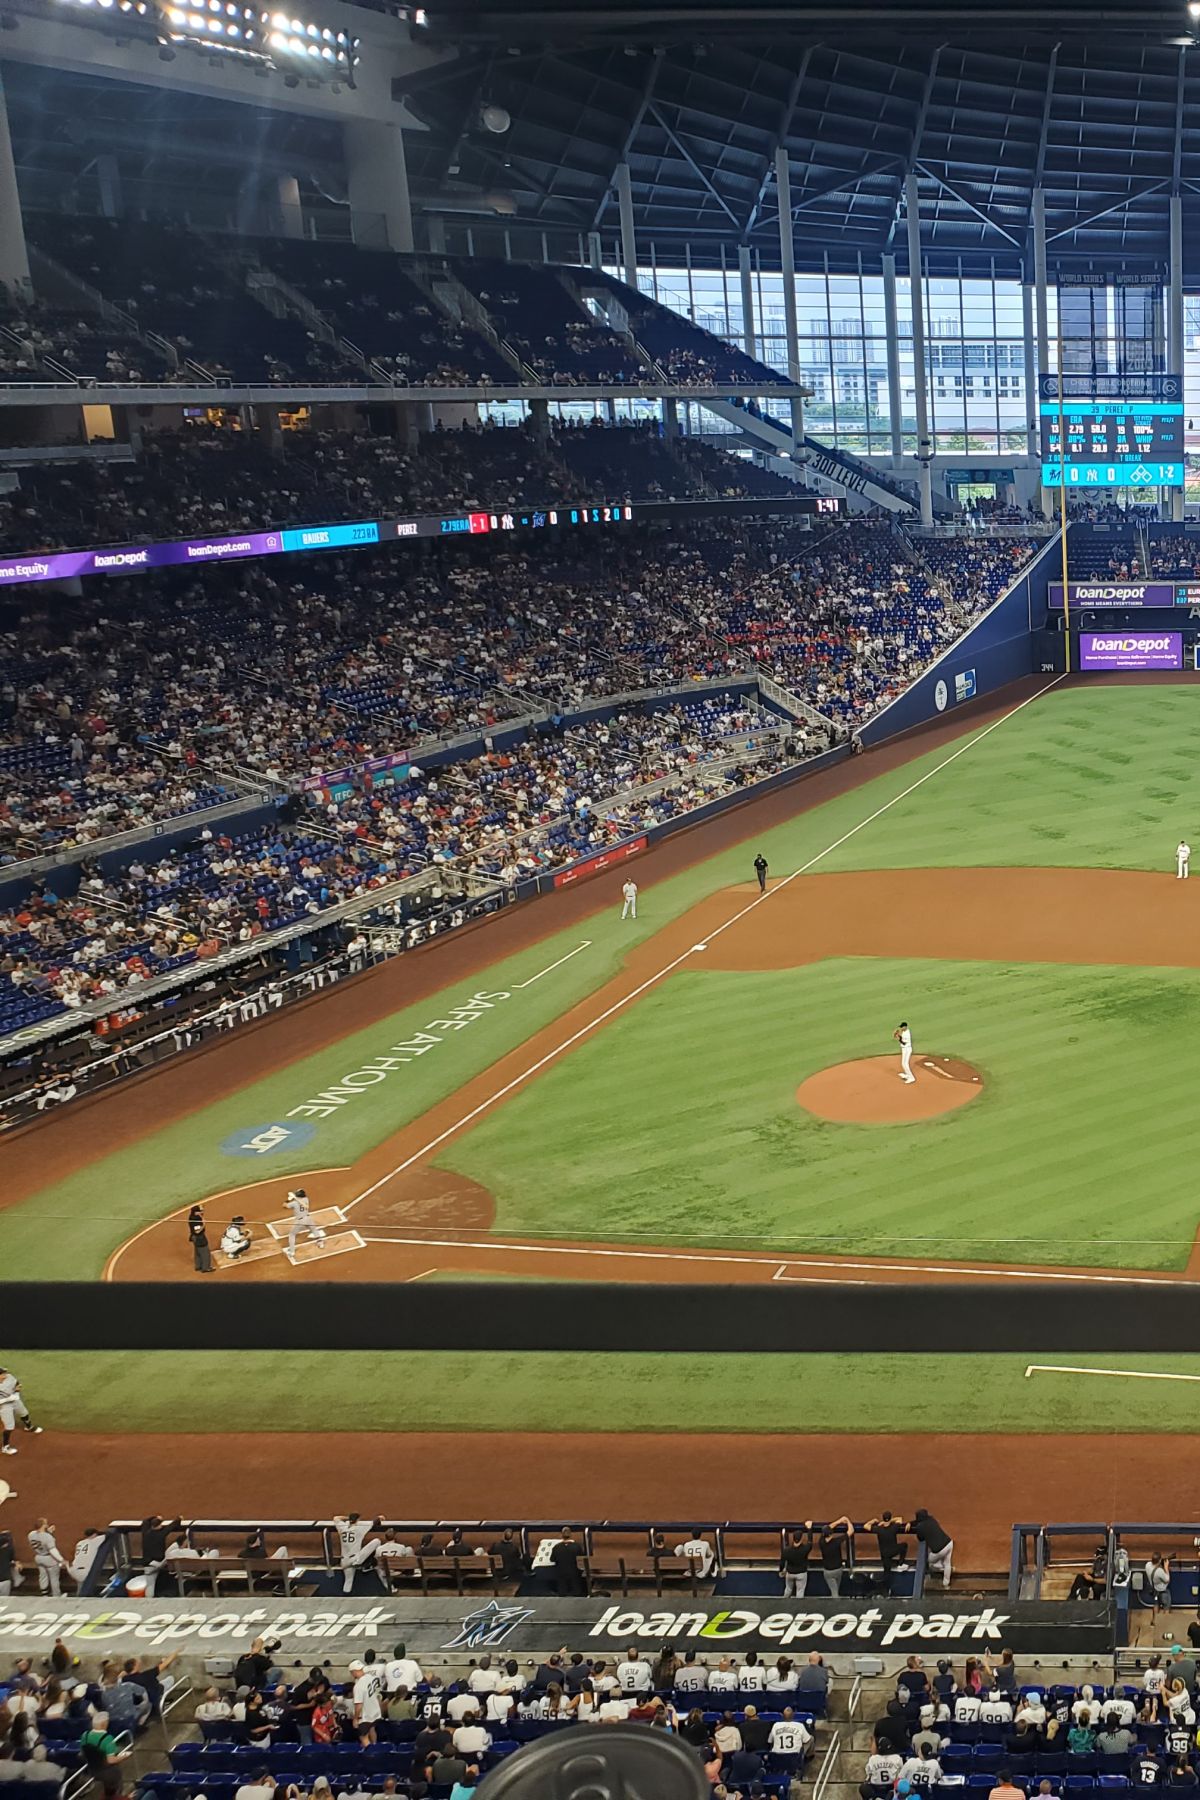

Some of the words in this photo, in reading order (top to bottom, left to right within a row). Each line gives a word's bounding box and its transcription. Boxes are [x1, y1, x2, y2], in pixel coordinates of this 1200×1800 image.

[1051, 425, 1059, 433] 13
[1069, 425, 1084, 434] 2.79
[1117, 426, 1125, 434] 19
[1133, 426, 1153, 434] 100%
[1135, 435, 1153, 443] WHIP
[811, 452, 837, 478] 300
[835, 465, 868, 495] LEVEL
[1071, 468, 1078, 481] 0
[1107, 468, 1115, 481] 0
[816, 499, 839, 513] 1:41
[550, 511, 558, 525] 0
[582, 509, 588, 523] 1
[604, 508, 612, 521] 2
[397, 523, 418, 536] PEREZ
[302, 531, 329, 545] BAUERS
[188, 541, 251, 557] loanDepot.com
[94, 549, 147, 567] loanDepot
[16, 562, 49, 578] Equity
[1075, 586, 1146, 601] loanDepot
[1091, 638, 1170, 653] loanDepot
[424, 990, 512, 1031] SAFE
[390, 1032, 444, 1056] AT
[286, 1057, 412, 1118] HOME
[240, 1125, 293, 1153] ADT
[342, 1532, 355, 1543] 26
[0, 1606, 268, 1645] oanDepot
[257, 1606, 399, 1644] park
[588, 1606, 884, 1645] loanDepot
[880, 1607, 1012, 1646] park
[627, 1677, 635, 1688] 2
[682, 1678, 698, 1691] 45
[741, 1677, 757, 1689] 45
[423, 1704, 442, 1719] 99
[959, 1707, 976, 1722] 27
[779, 1735, 794, 1749] 13
[1172, 1740, 1188, 1753] 99
[880, 1770, 889, 1782] 6
[1141, 1769, 1156, 1783] 13
